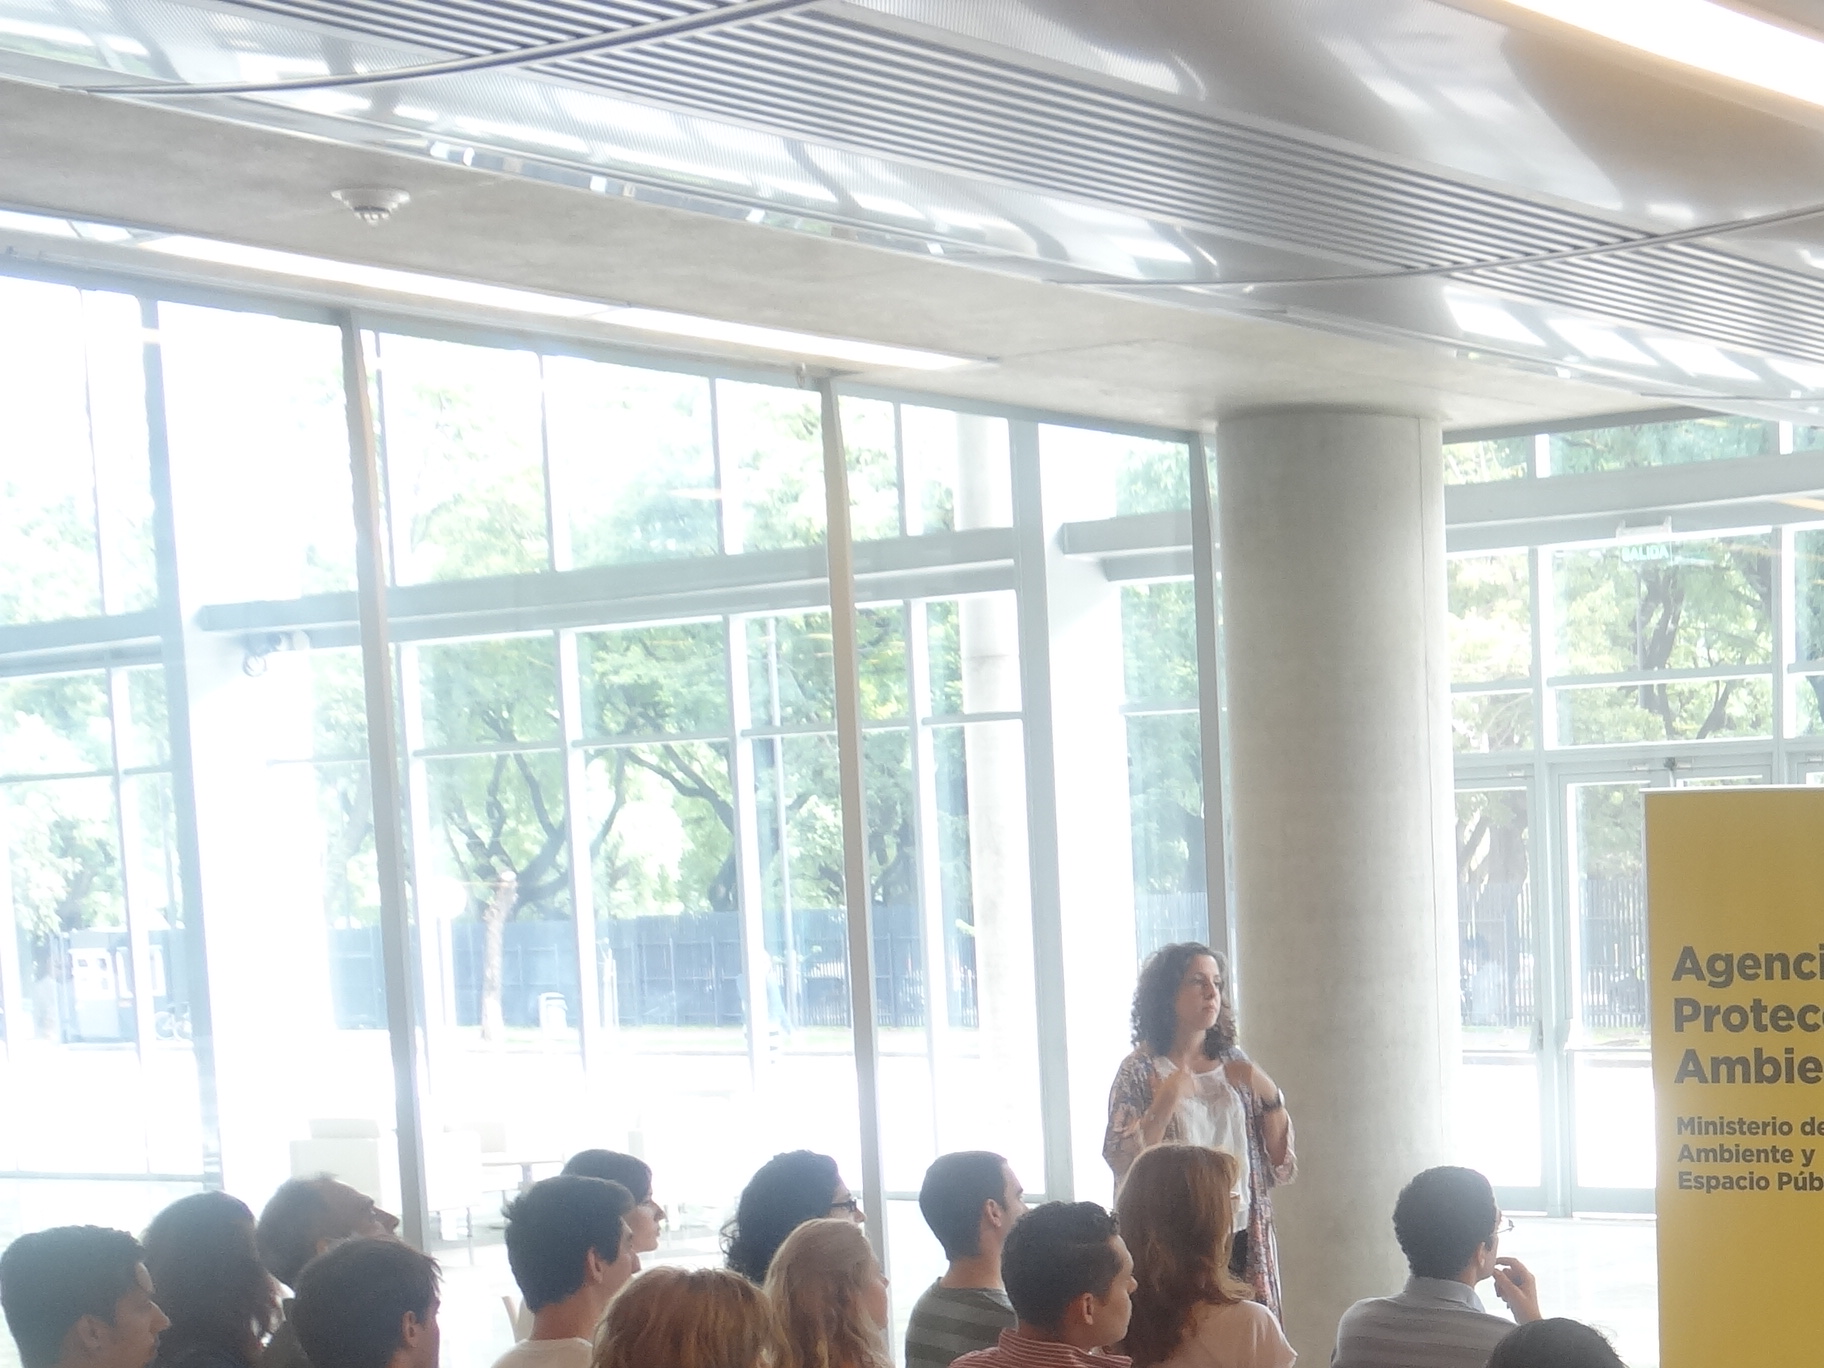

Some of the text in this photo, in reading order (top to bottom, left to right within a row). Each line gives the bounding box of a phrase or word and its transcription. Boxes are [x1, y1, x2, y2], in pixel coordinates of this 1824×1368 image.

[1621, 544, 1669, 562] SALIDA
[1677, 1116, 1793, 1136] Ministerio
[1677, 1143, 1816, 1167] Ambiente y
[1678, 1171, 1770, 1194] Espacio
